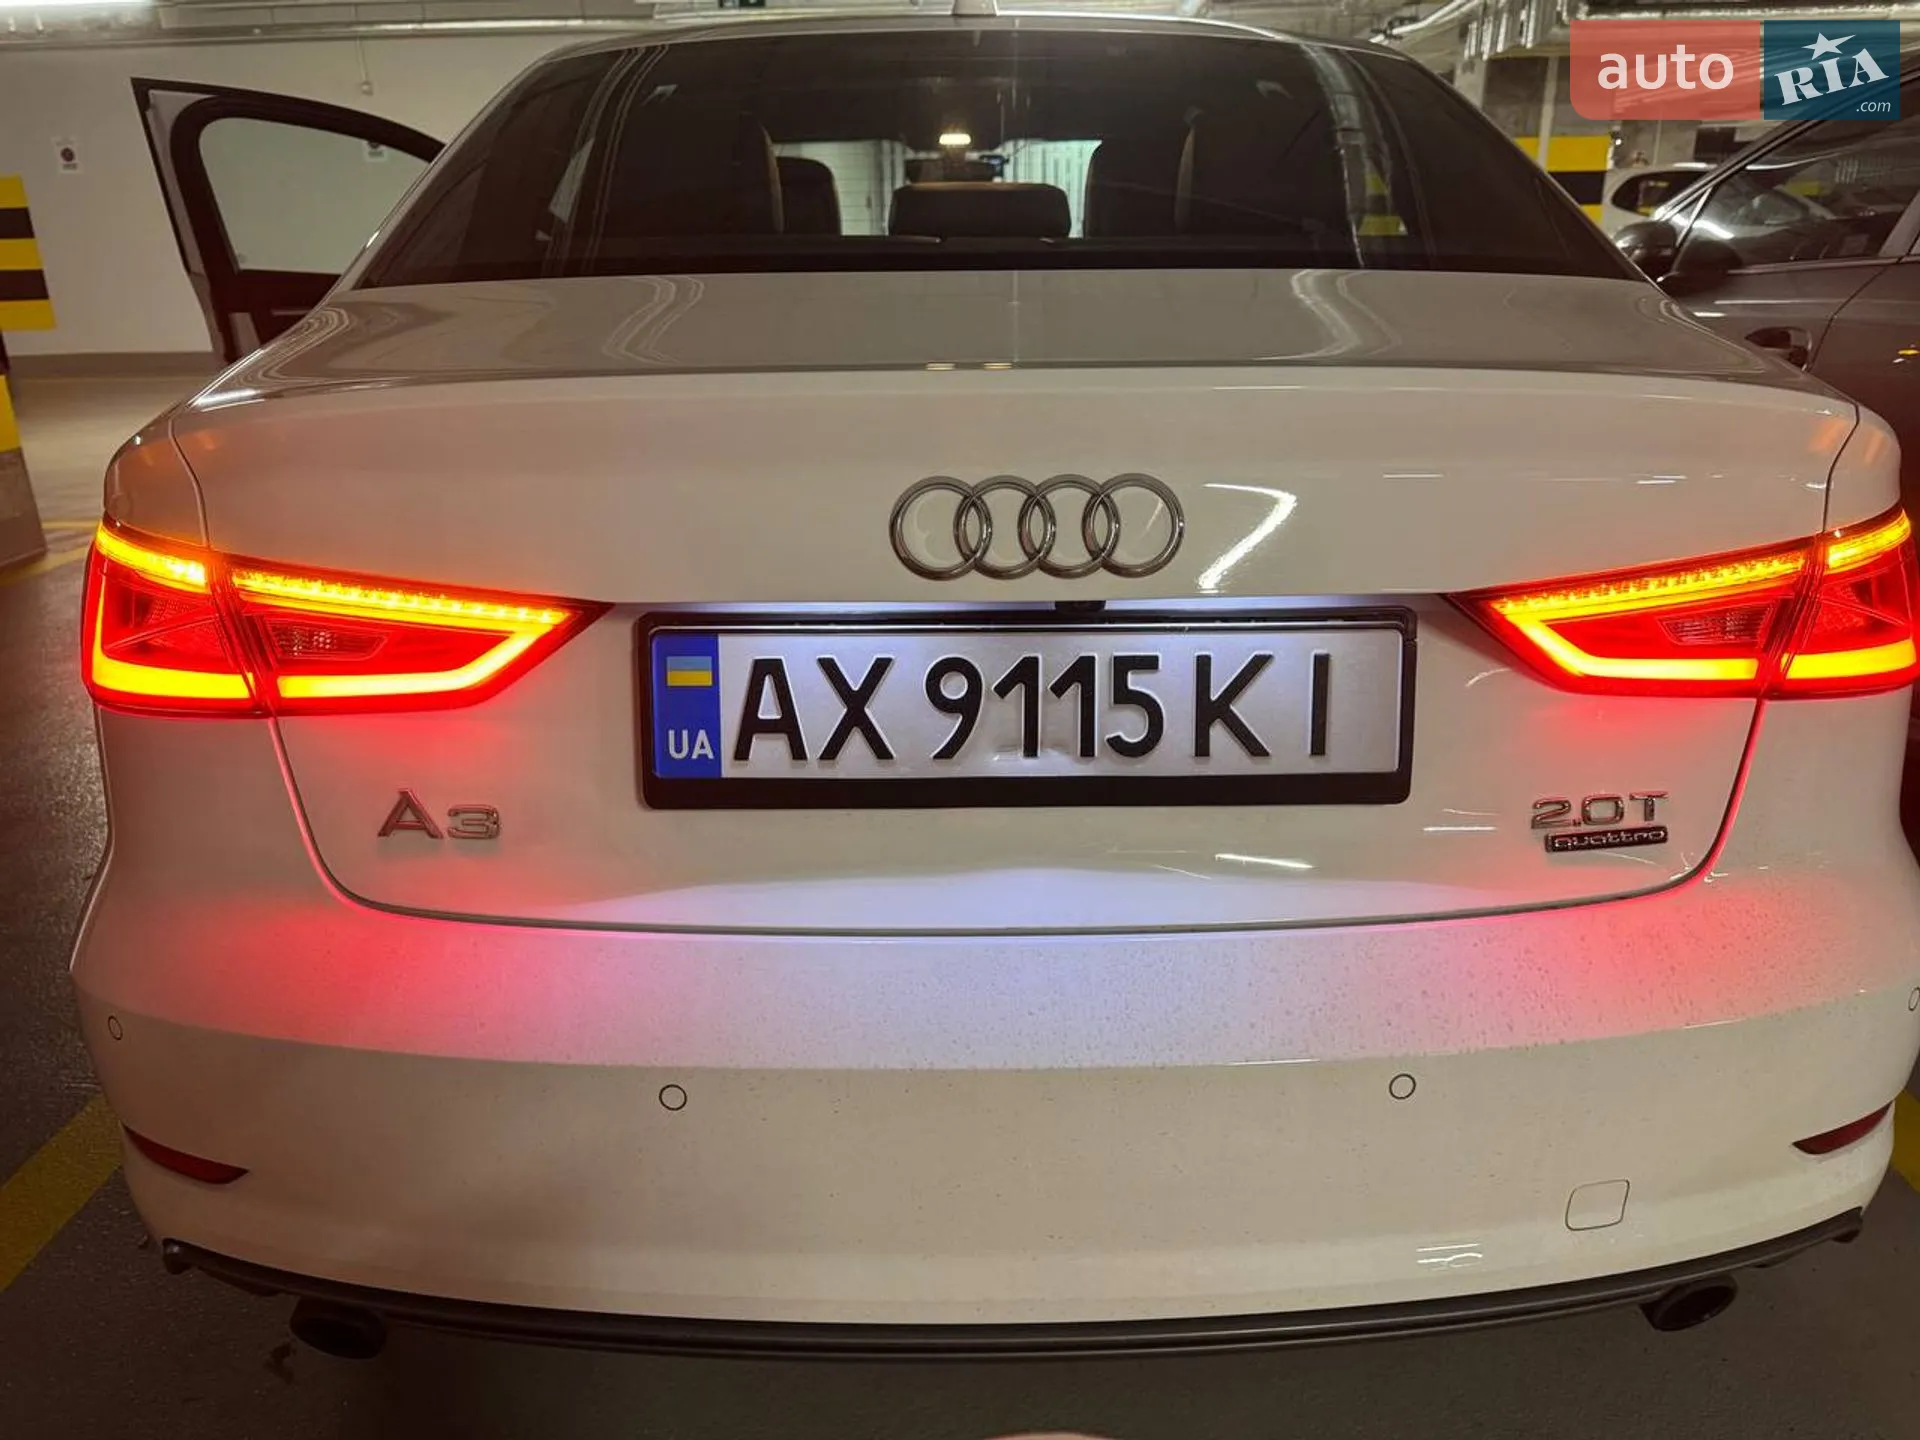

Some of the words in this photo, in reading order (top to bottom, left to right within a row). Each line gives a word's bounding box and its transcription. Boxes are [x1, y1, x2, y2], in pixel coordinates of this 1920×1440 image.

[732, 654, 895, 762] AX
[922, 652, 1165, 760] 9115
[667, 729, 715, 760] UA
[377, 788, 501, 840] A3
[1531, 790, 1669, 829] 2.0T
[1553, 830, 1666, 850] quattro
